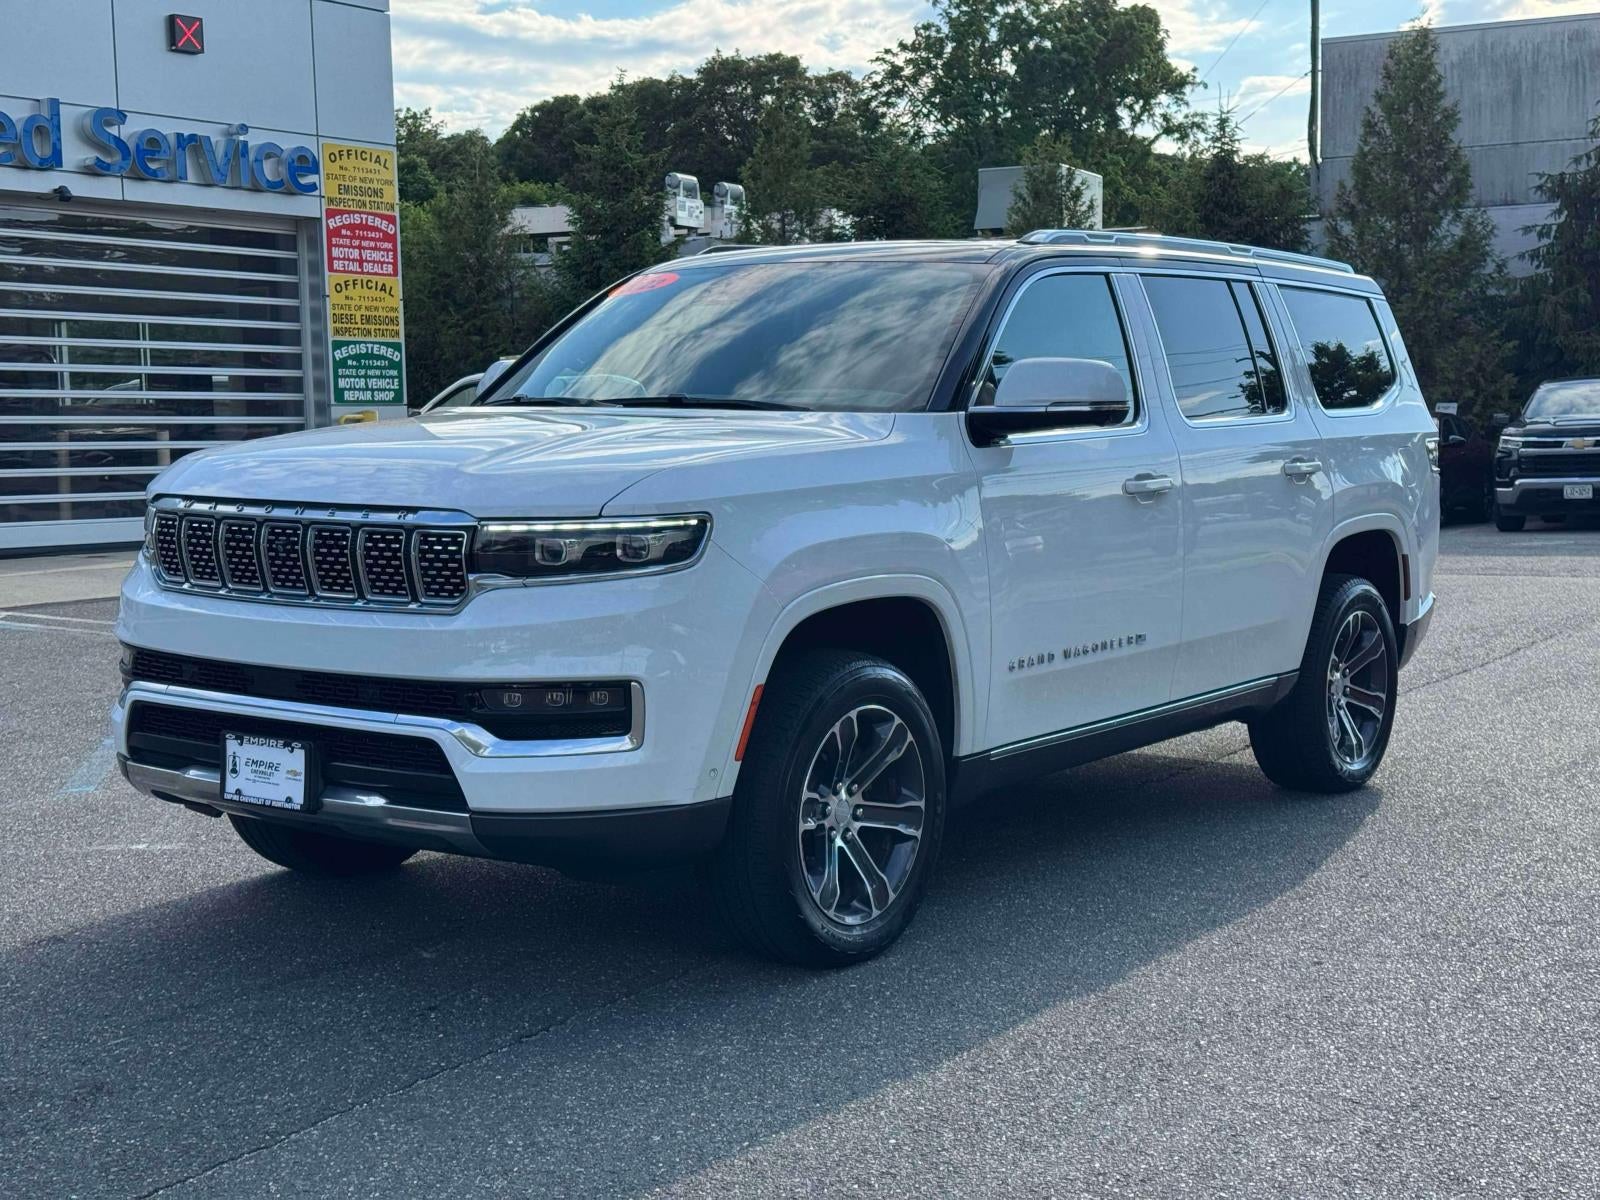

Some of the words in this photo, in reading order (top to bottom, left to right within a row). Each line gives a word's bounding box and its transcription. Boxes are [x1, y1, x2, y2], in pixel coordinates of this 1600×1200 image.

[85, 107, 319, 194] Service
[328, 149, 389, 170] OFFICIAL
[352, 166, 381, 174] 7113431
[325, 173, 347, 182] STATE
[348, 175, 357, 183] OF
[375, 178, 394, 187] YORK
[337, 184, 384, 199] EMISSIONS
[327, 196, 367, 209] INSPECTION
[368, 200, 395, 211] STATION
[327, 213, 396, 235] REGISTERED
[355, 230, 383, 238] 7113431
[331, 237, 351, 246] STATE
[361, 240, 375, 248] NEW
[376, 241, 393, 249] YORK
[331, 247, 360, 260] MOTOR
[361, 249, 394, 262] VEHICLE
[333, 260, 361, 272] RETAIL
[363, 262, 393, 274] DEALER
[334, 278, 394, 298] OFFICIAL
[331, 303, 353, 312] STATE
[353, 304, 363, 312] OF
[364, 305, 379, 313] NEW
[380, 306, 399, 314] YORK
[332, 313, 358, 325] DIESEL
[360, 314, 400, 327] EMISSIONS
[333, 326, 373, 338] INSPECTION
[373, 328, 400, 338] STATION
[333, 343, 401, 362] REGISTERED
[338, 368, 357, 376] STATE
[382, 369, 399, 377] YORK
[338, 378, 366, 389] MOTOR
[367, 378, 400, 389] VEHICLE
[344, 390, 372, 401] REPAIR
[373, 390, 395, 401] SHOP
[181, 498, 409, 521] WAGONEER
[1008, 651, 1056, 673] GRAND
[1062, 634, 1134, 661] WAGONEER
[243, 735, 285, 749] EMPIRE
[244, 757, 282, 772] EMPIRE
